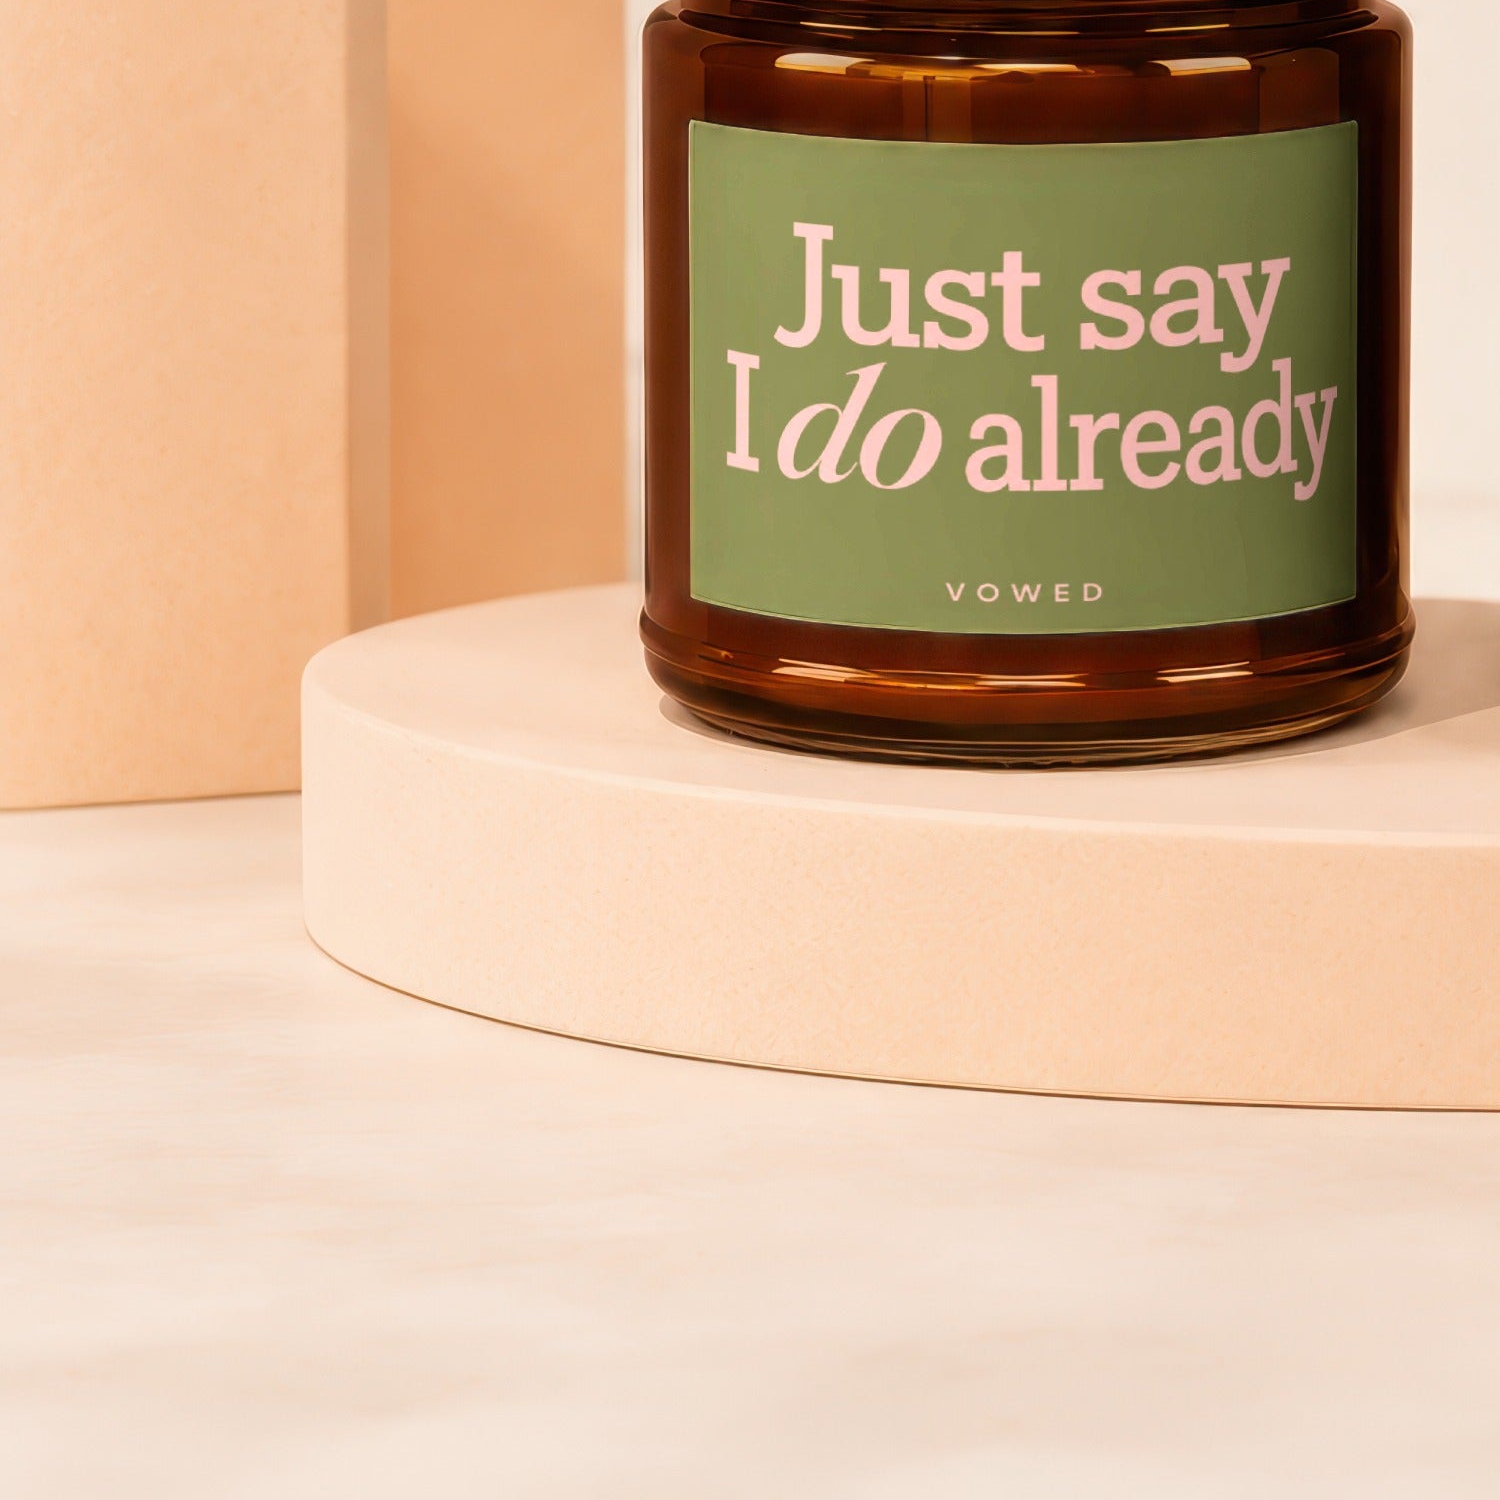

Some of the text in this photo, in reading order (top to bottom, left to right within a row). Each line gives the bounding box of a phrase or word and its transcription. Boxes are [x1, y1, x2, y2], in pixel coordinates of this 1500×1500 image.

[773, 221, 1291, 373] Just say
[725, 349, 1338, 501] I do already
[944, 582, 1104, 603] VOWED
